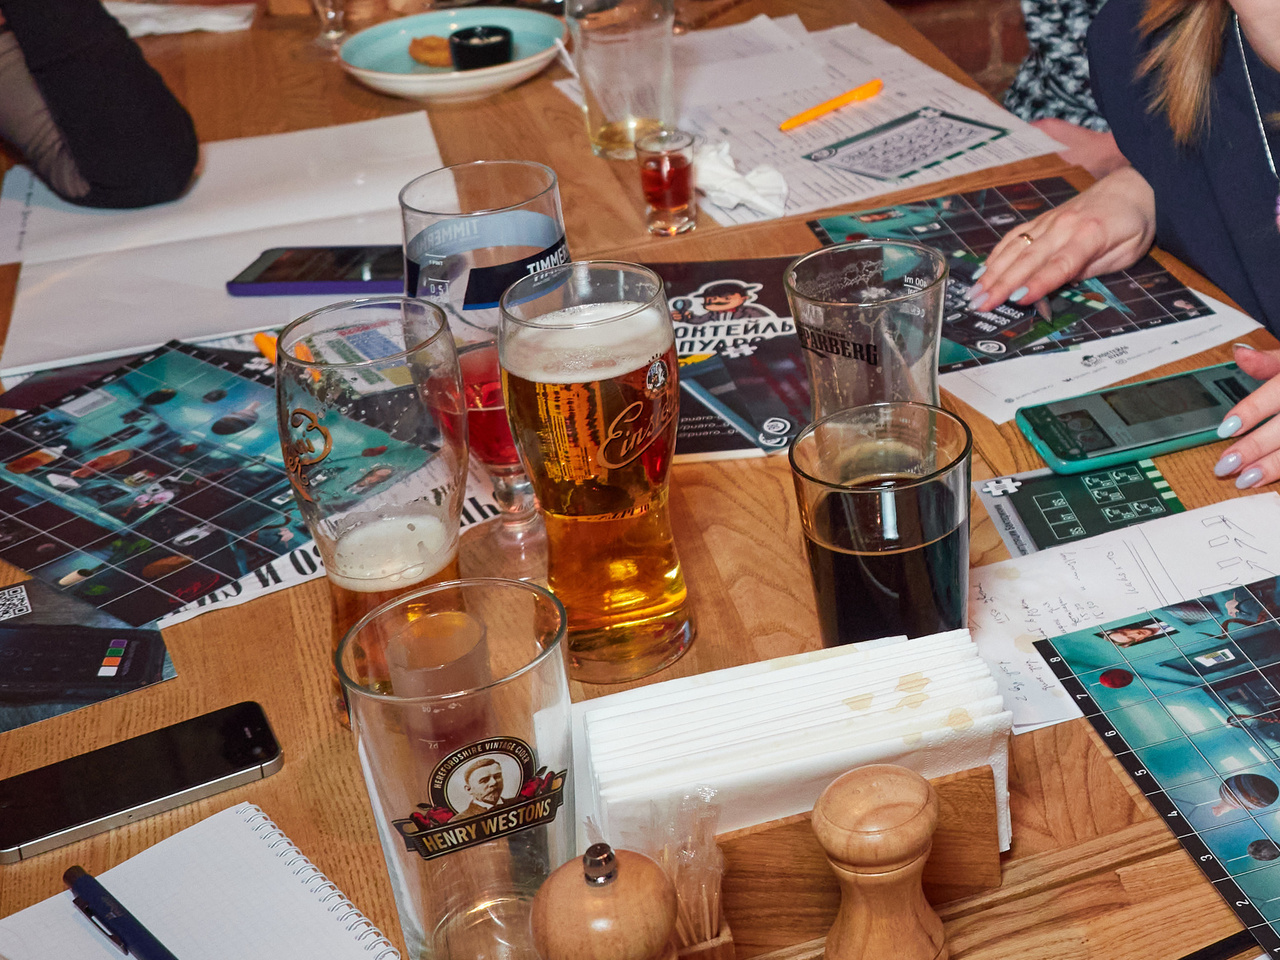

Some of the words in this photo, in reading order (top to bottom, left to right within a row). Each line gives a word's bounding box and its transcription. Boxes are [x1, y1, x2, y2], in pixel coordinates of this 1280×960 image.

[675, 319, 794, 339] ОКТЕЙЛЬ
[1050, 655, 1061, 663] 8
[1076, 692, 1088, 700] 7
[1105, 729, 1116, 737] 6
[433, 744, 483, 789] HEREFORDSHIRE
[485, 740, 516, 751] VINTAGE
[515, 745, 531, 765] CIDER
[1135, 768, 1147, 777] 5
[1167, 809, 1178, 818] 4
[422, 823, 477, 853] HENRY
[481, 798, 552, 836] WESTONS
[1200, 853, 1213, 862] 3
[1235, 898, 1249, 907] 2
